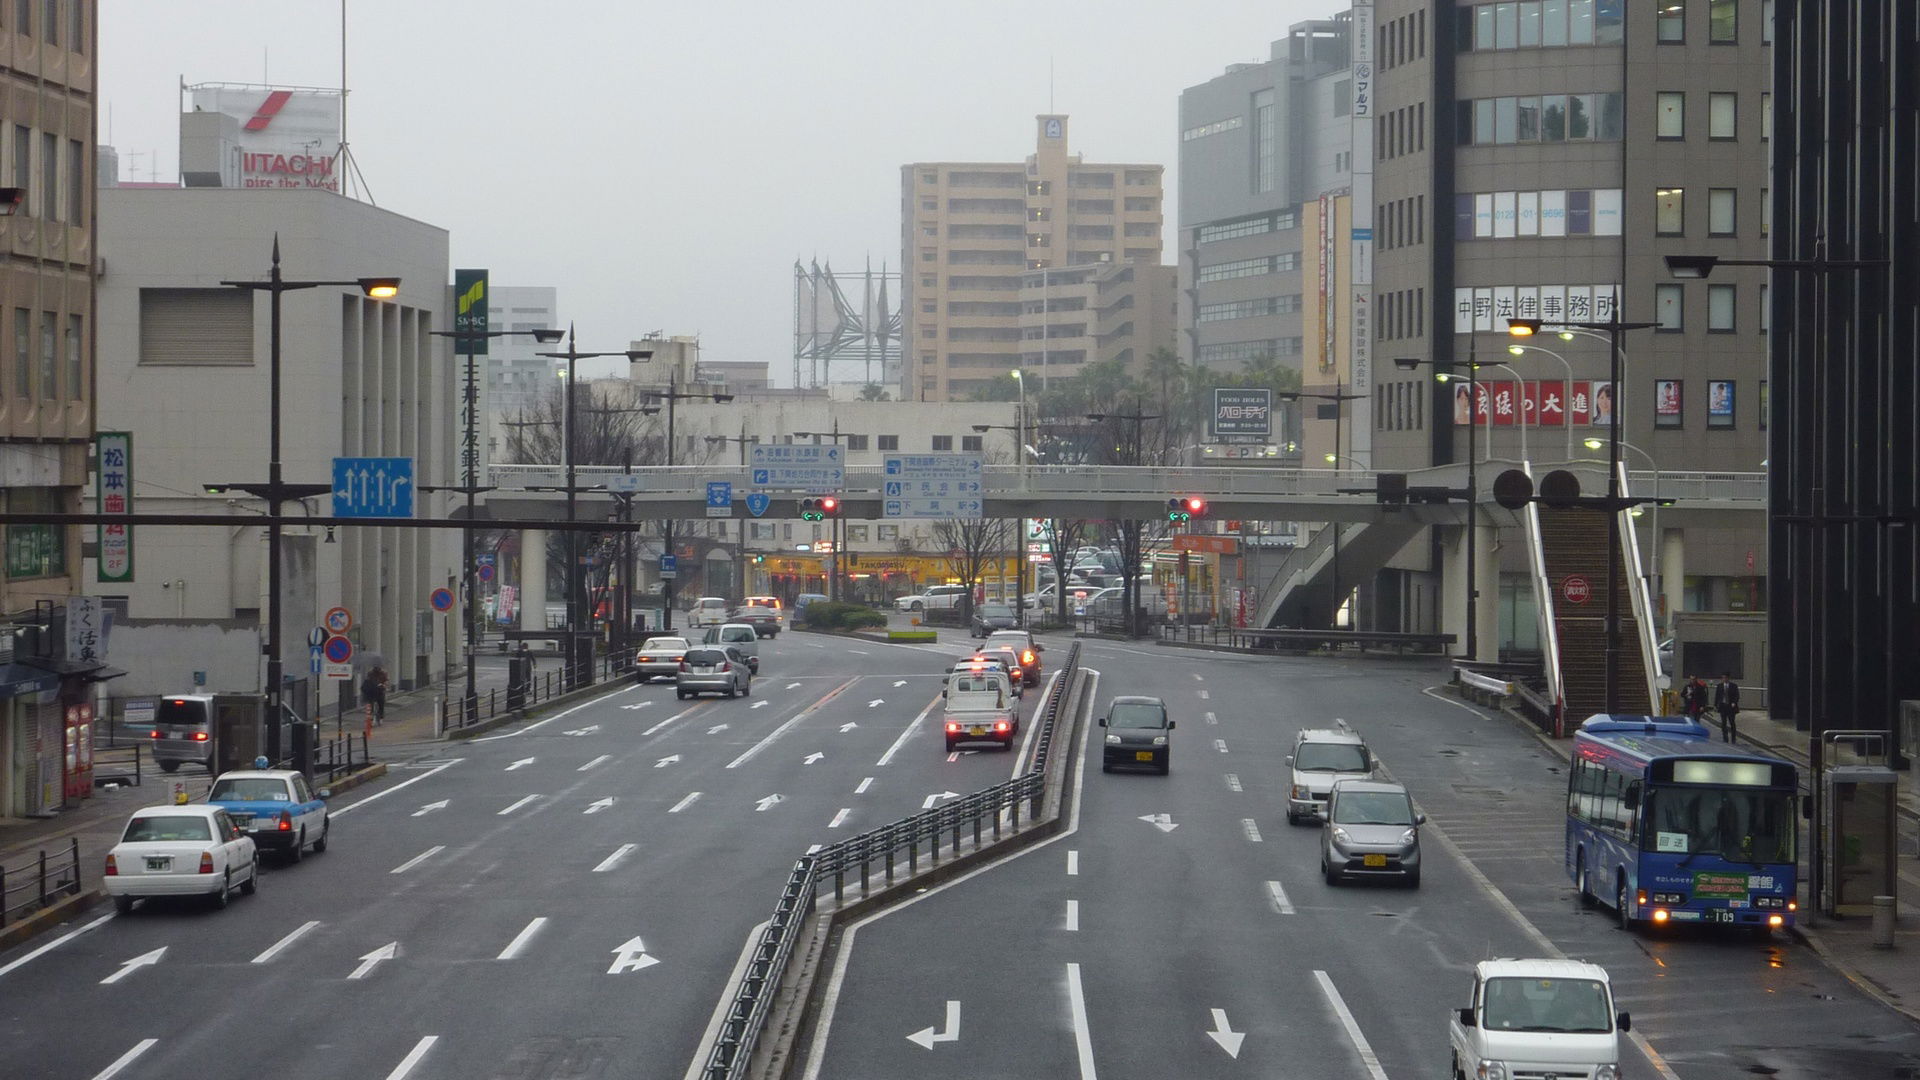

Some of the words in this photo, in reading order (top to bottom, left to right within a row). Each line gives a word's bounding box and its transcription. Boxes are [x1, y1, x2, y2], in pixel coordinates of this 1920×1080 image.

[1356, 82, 1368, 115] マルコ
[1459, 296, 1614, 319] 中野法律事務所
[460, 364, 481, 487] 三井住友銀行
[1241, 448, 1249, 458] P
[104, 448, 125, 536] 松本歯科
[754, 500, 761, 508] 9
